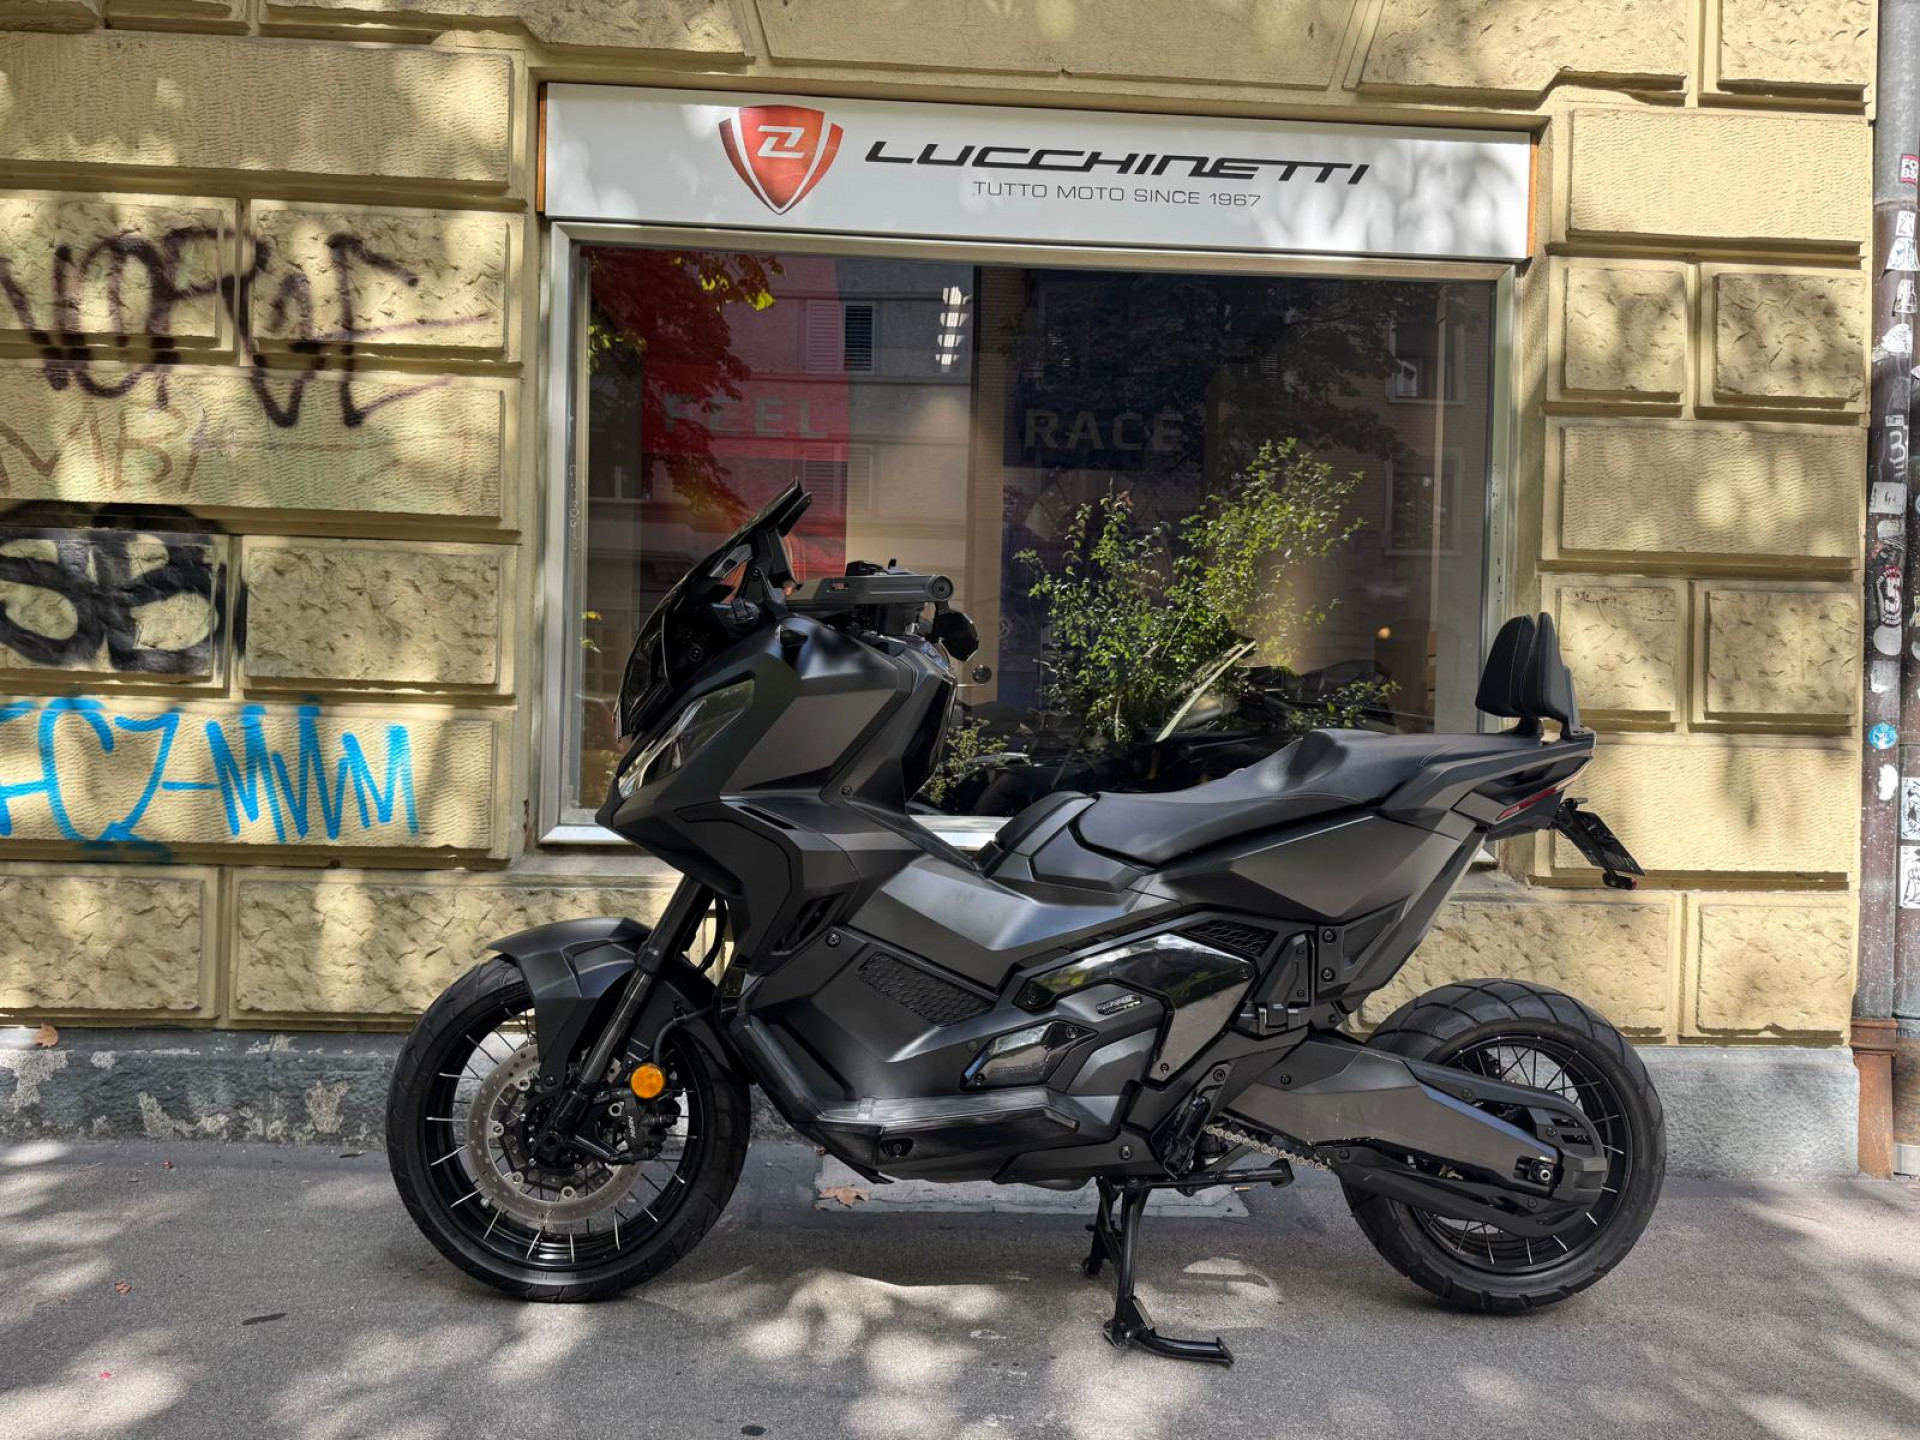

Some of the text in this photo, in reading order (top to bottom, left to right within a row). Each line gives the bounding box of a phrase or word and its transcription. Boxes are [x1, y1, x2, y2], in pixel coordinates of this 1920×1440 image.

[864, 141, 1370, 185] LUCCHINETTI
[973, 181, 1261, 207] TUTTO MOTO SINCE 1967
[664, 393, 828, 438] FEEL
[1024, 408, 1184, 450] RACE
